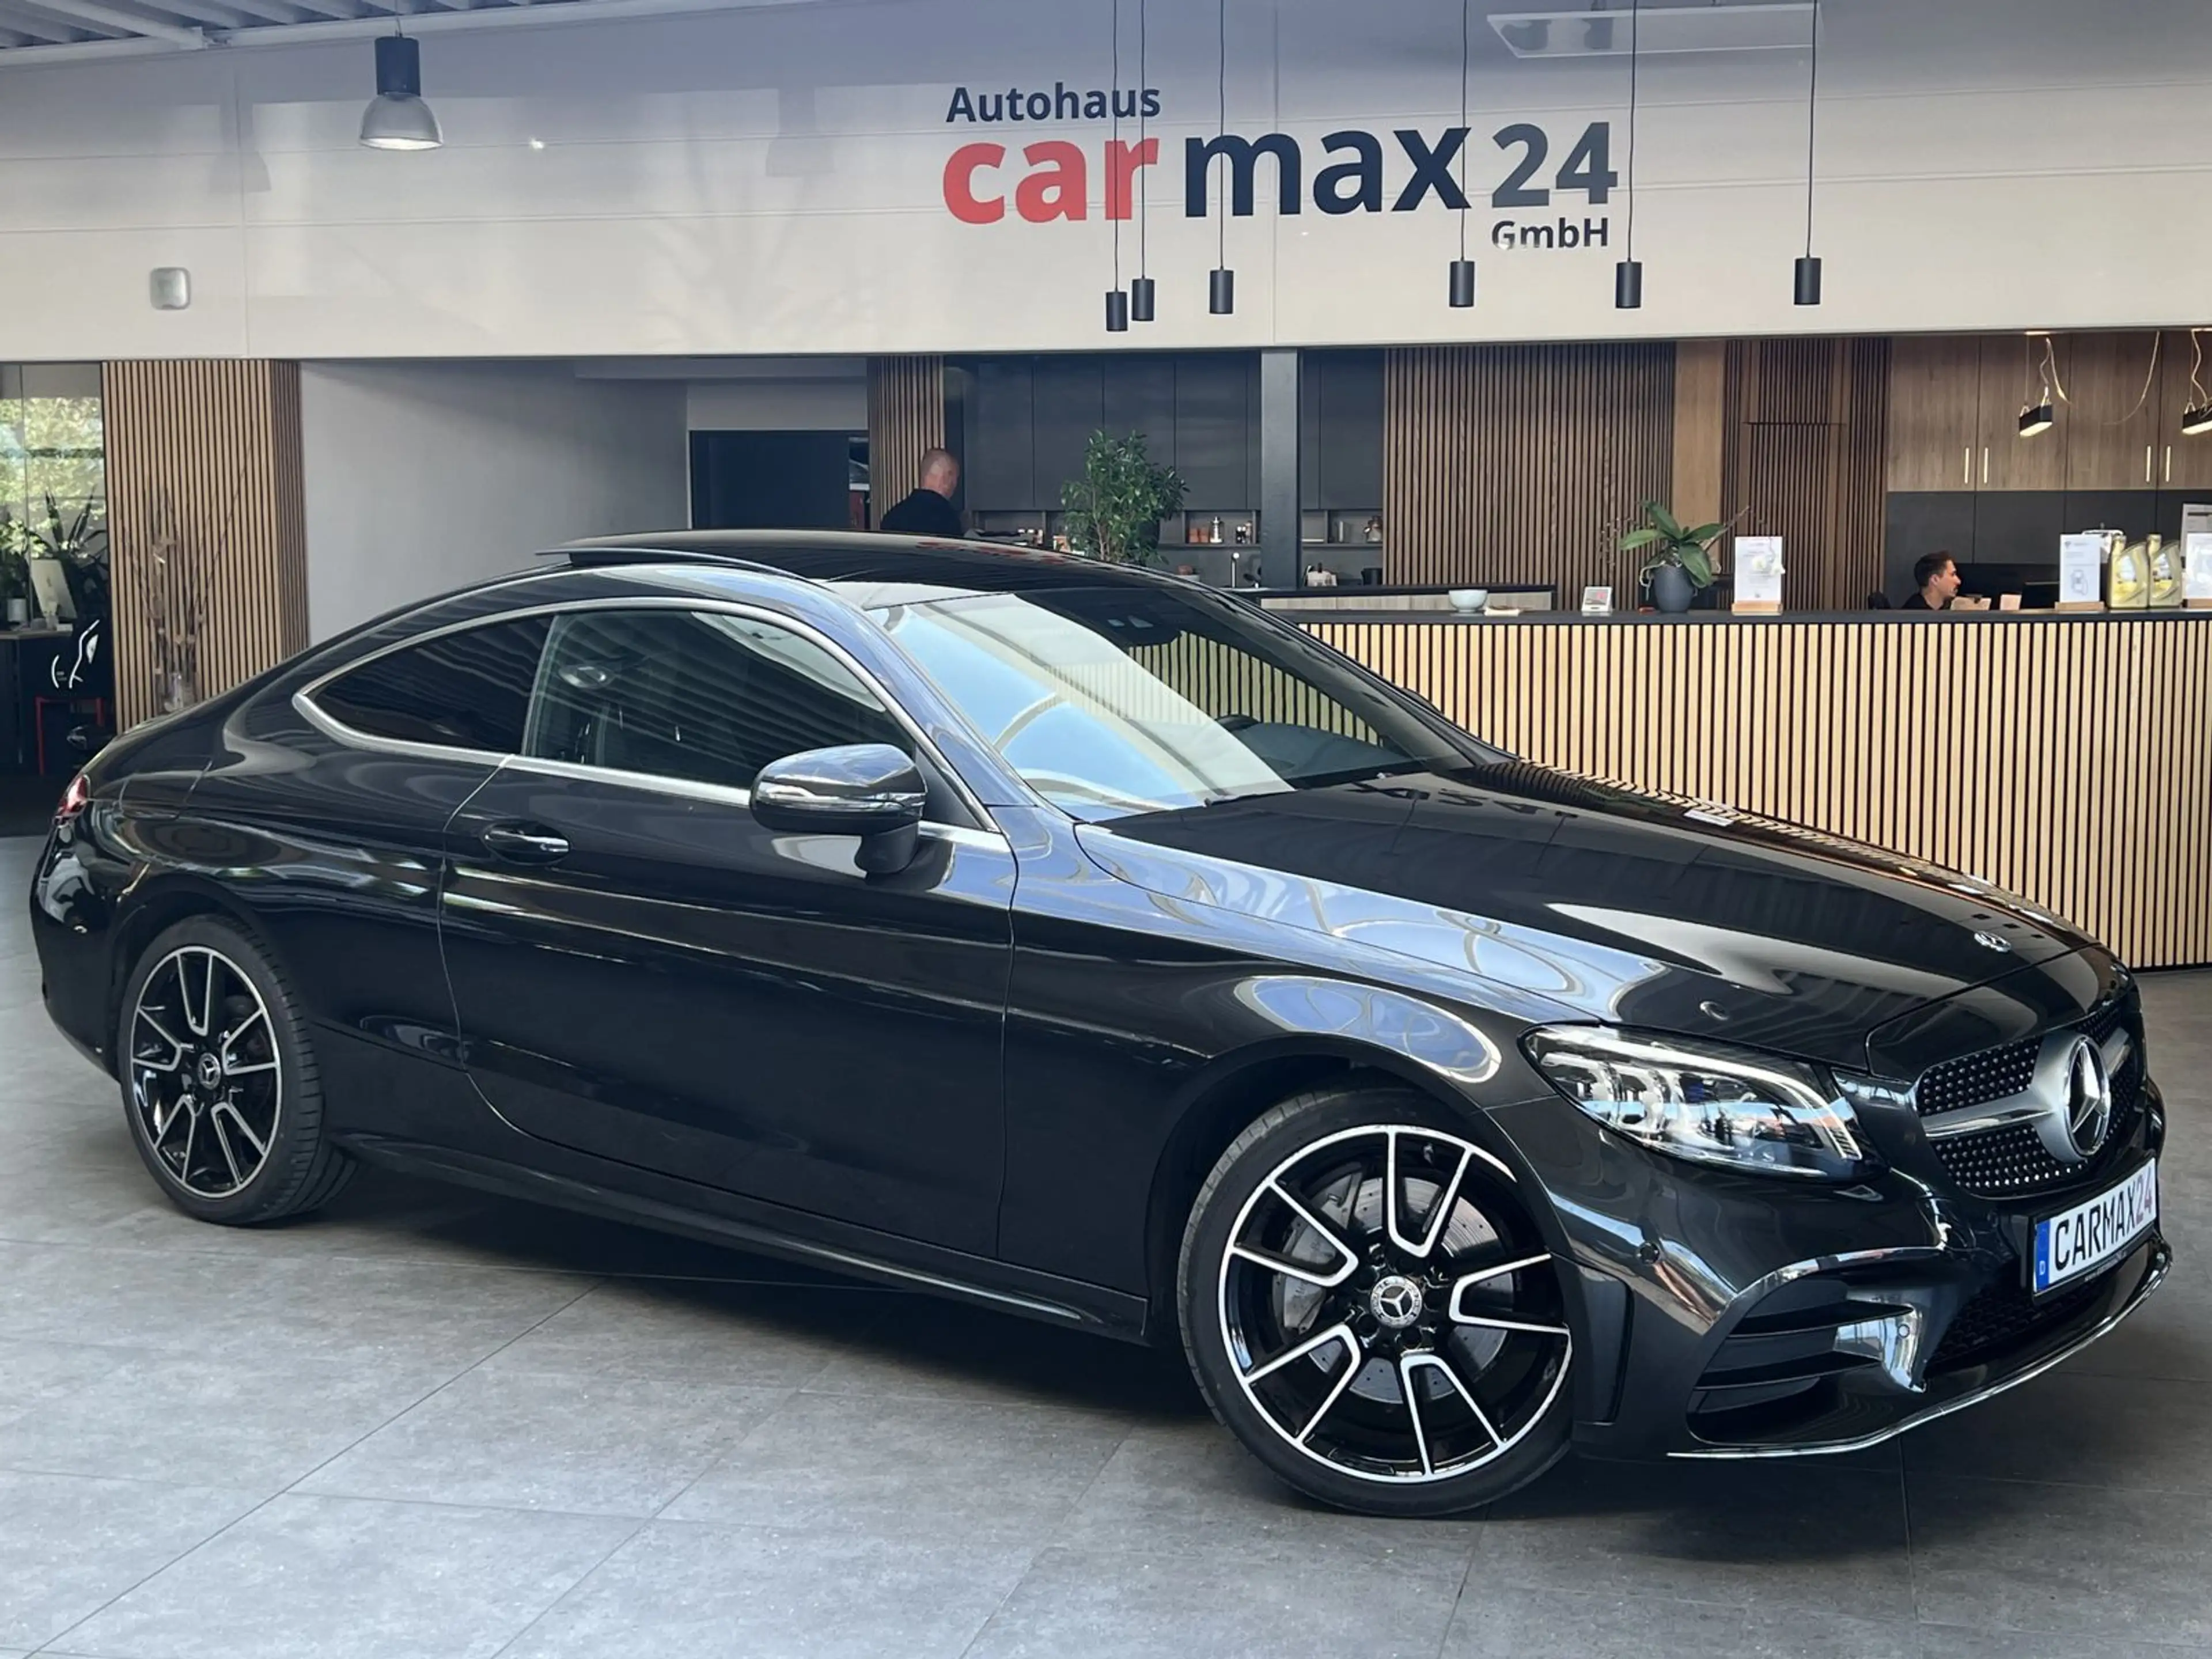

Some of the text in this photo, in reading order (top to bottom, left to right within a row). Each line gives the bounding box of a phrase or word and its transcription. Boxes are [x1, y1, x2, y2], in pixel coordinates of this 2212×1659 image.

[945, 82, 1161, 123] Autohaus
[1491, 217, 1608, 250] GmbH
[2054, 1166, 2153, 1272] CARMAX24
